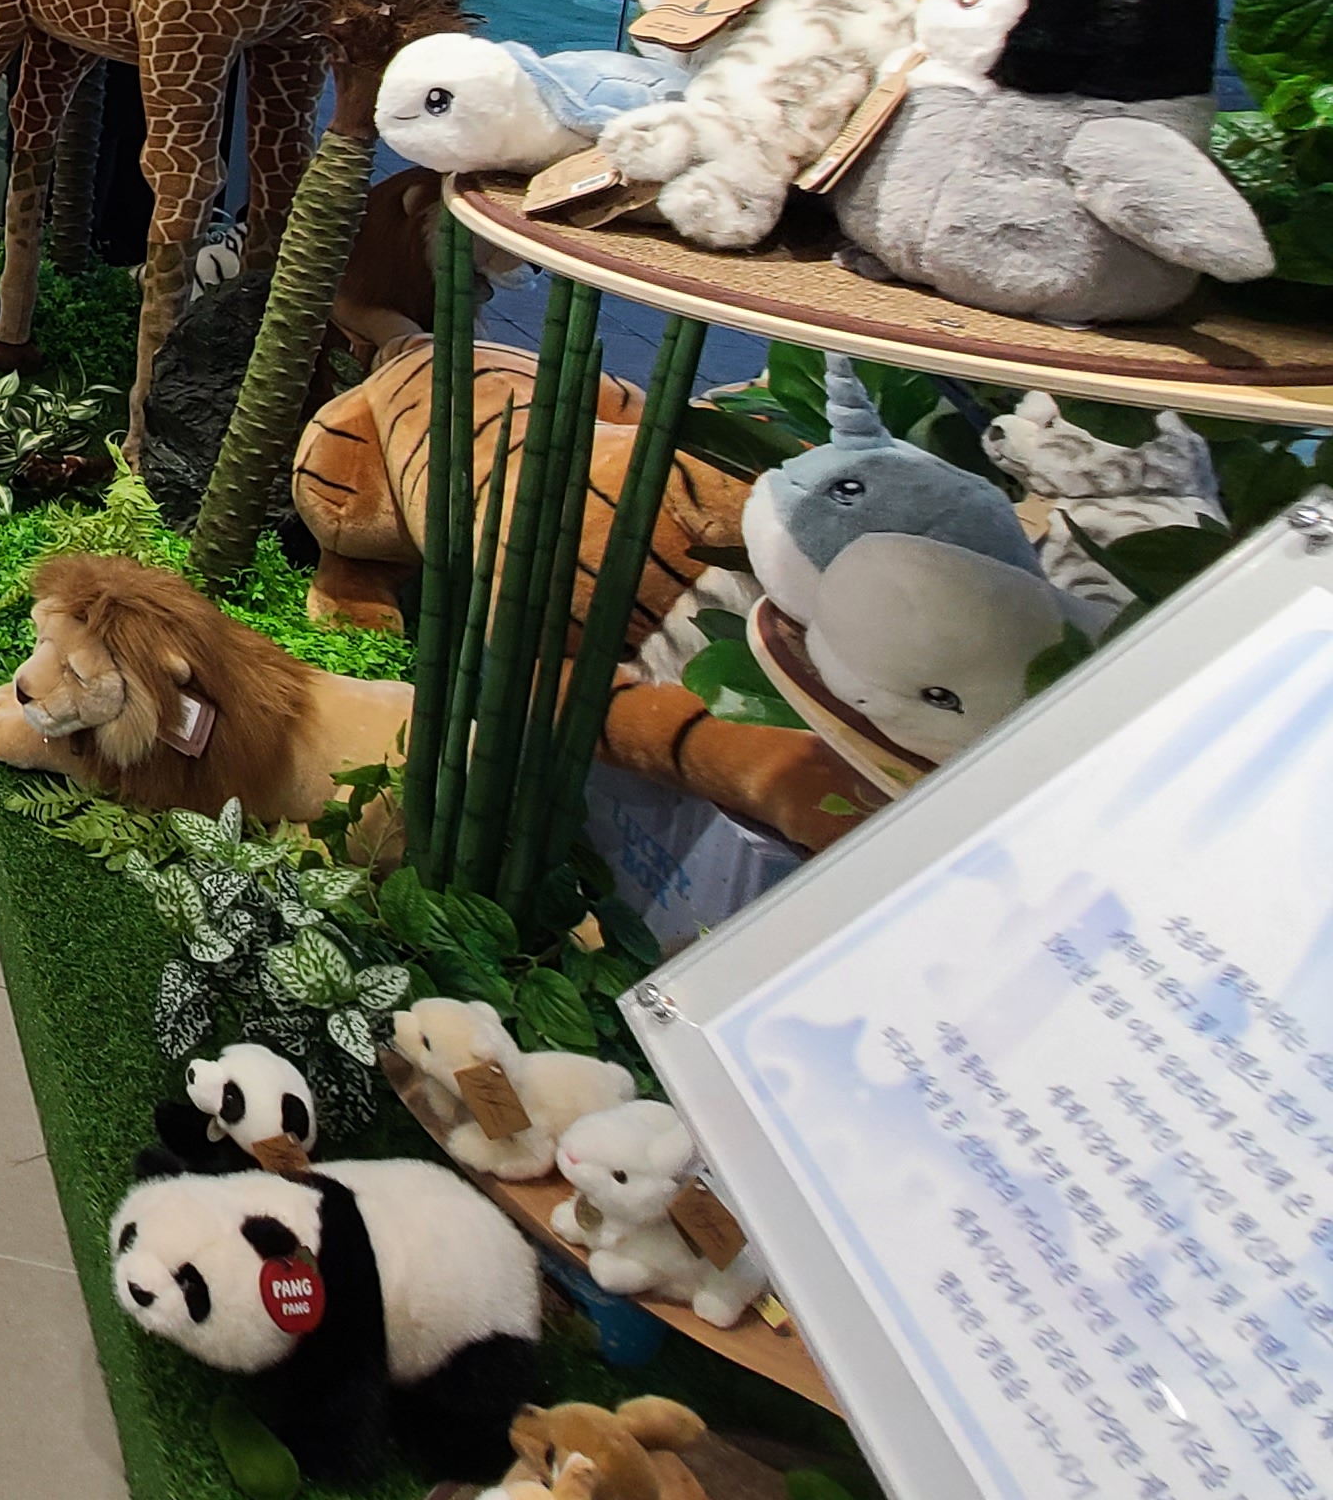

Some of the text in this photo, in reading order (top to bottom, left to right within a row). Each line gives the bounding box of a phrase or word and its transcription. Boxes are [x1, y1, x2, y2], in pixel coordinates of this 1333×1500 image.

[1173, 1151, 1237, 1214] 디자인
[271, 1278, 313, 1299] PANG
[281, 1301, 311, 1317] PANG
[1167, 1327, 1238, 1398] 그리고
[1167, 1418, 1231, 1490] 기준을
